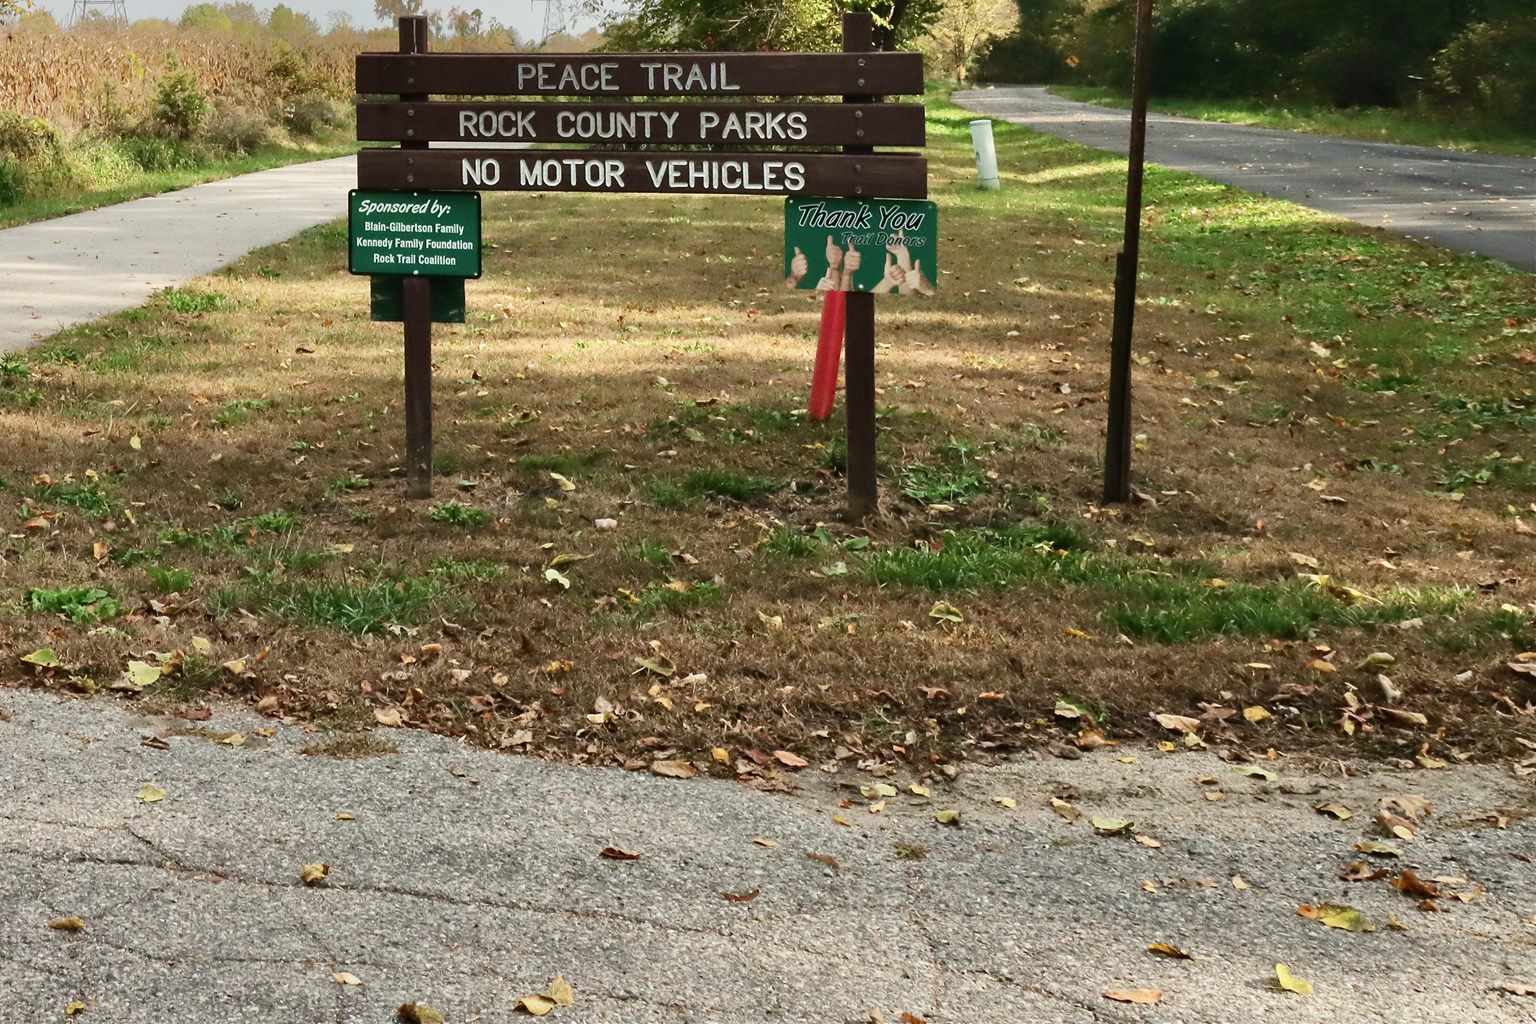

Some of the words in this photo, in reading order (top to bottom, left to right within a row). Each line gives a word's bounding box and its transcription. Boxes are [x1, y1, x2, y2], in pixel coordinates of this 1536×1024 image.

[517, 62, 620, 91] PEACE
[640, 62, 740, 91] TRAIL
[458, 111, 537, 139] ROCK
[556, 111, 680, 140] COUNTY
[699, 112, 808, 141] PARKS
[461, 158, 501, 187] NO
[519, 158, 626, 189] MOTOR
[645, 160, 807, 192] VEHICLES
[358, 199, 431, 215] Sponsored
[431, 200, 452, 218] by:
[798, 202, 873, 230] Thank
[879, 204, 926, 231] You
[364, 221, 433, 233] Blain-Gilbertson
[435, 223, 465, 236] Family
[356, 237, 393, 249] Kennedy
[395, 238, 424, 250] Family
[426, 239, 474, 251] Foundation
[841, 231, 875, 246] Trail
[875, 232, 928, 247] Donors
[373, 253, 396, 264] Rock
[396, 254, 416, 265] Trail
[418, 255, 457, 266] Coalition
